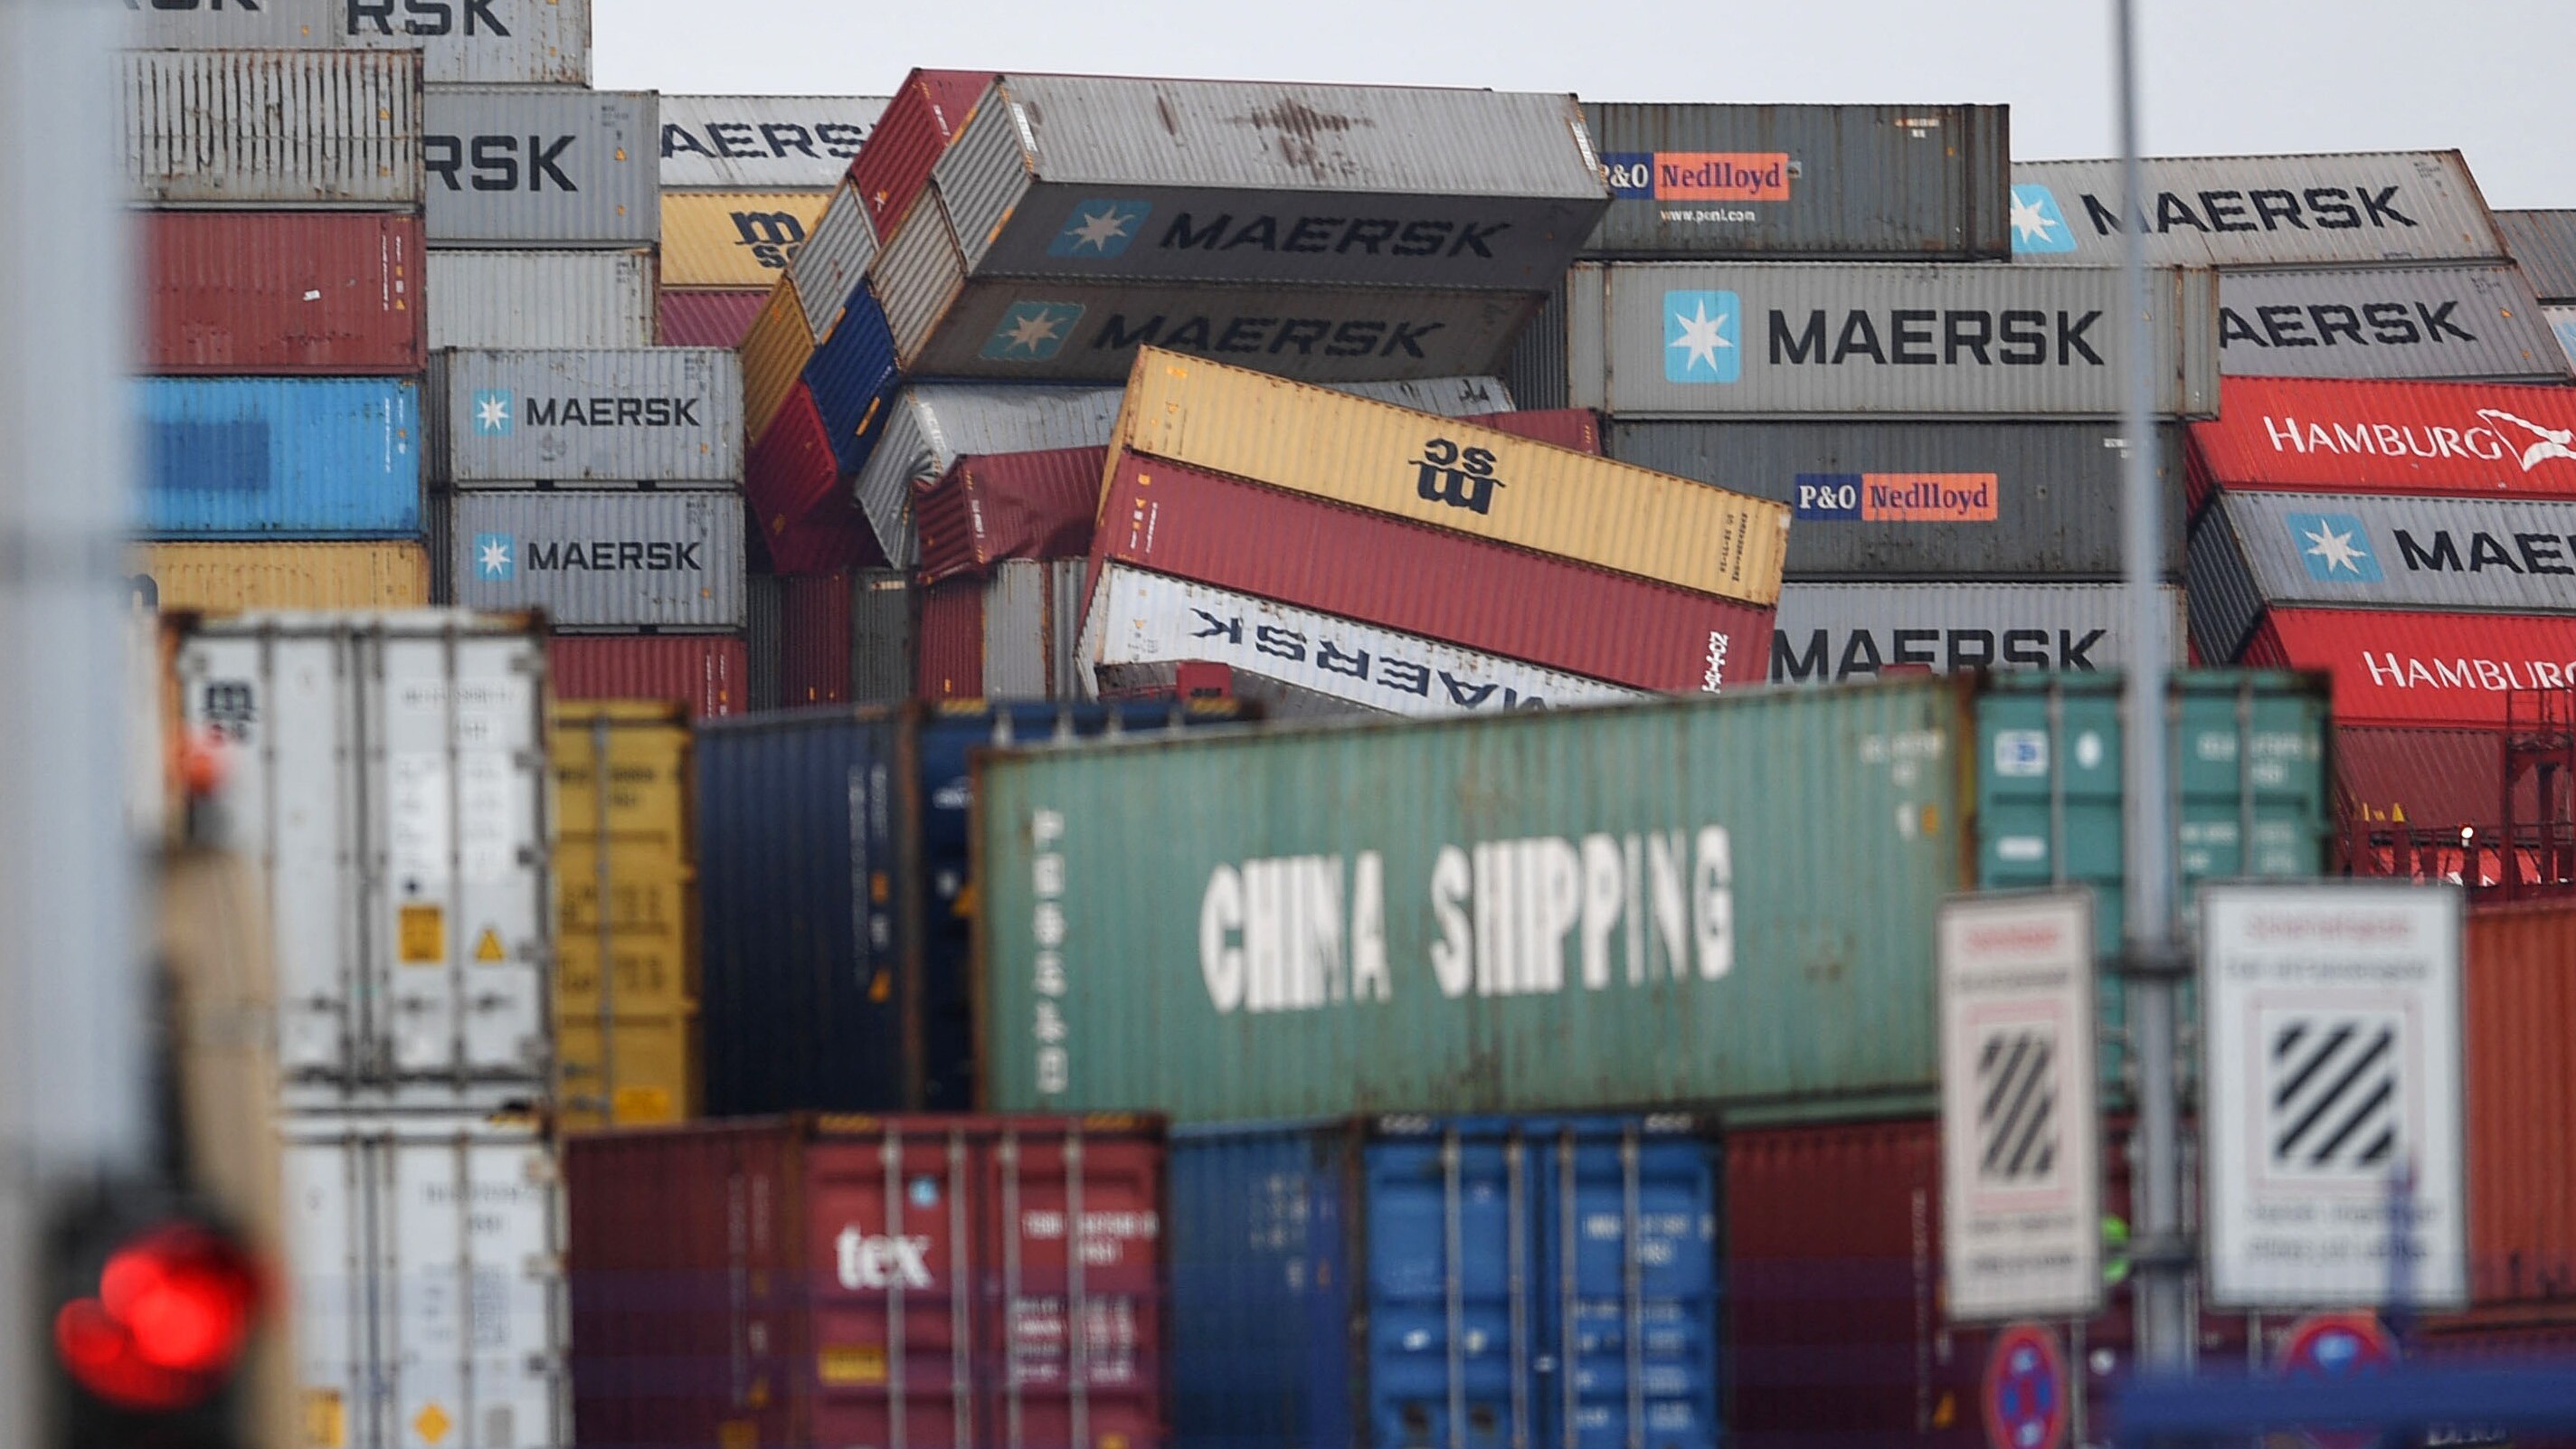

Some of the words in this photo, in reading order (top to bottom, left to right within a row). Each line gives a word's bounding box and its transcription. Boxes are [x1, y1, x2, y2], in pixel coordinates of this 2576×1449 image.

[660, 122, 876, 159] AERS
[1662, 162, 1781, 194] Nedlloyd
[2080, 185, 2418, 236] MAERSK
[1159, 213, 1512, 259] MAERSK
[1094, 315, 1445, 360] MAERSK
[1768, 309, 2104, 365] MAERSK
[526, 397, 701, 427] MAERSK
[2263, 416, 2502, 459] HAMBURG
[1798, 485, 1857, 510] P&O
[1870, 482, 1989, 516] Nedlloyd
[527, 542, 703, 571] MAERSK
[2393, 528, 2576, 576] MAE
[1199, 850, 1392, 1014] CHINA
[1430, 824, 1734, 999] SHIPPING
[836, 1221, 934, 1291] tex
